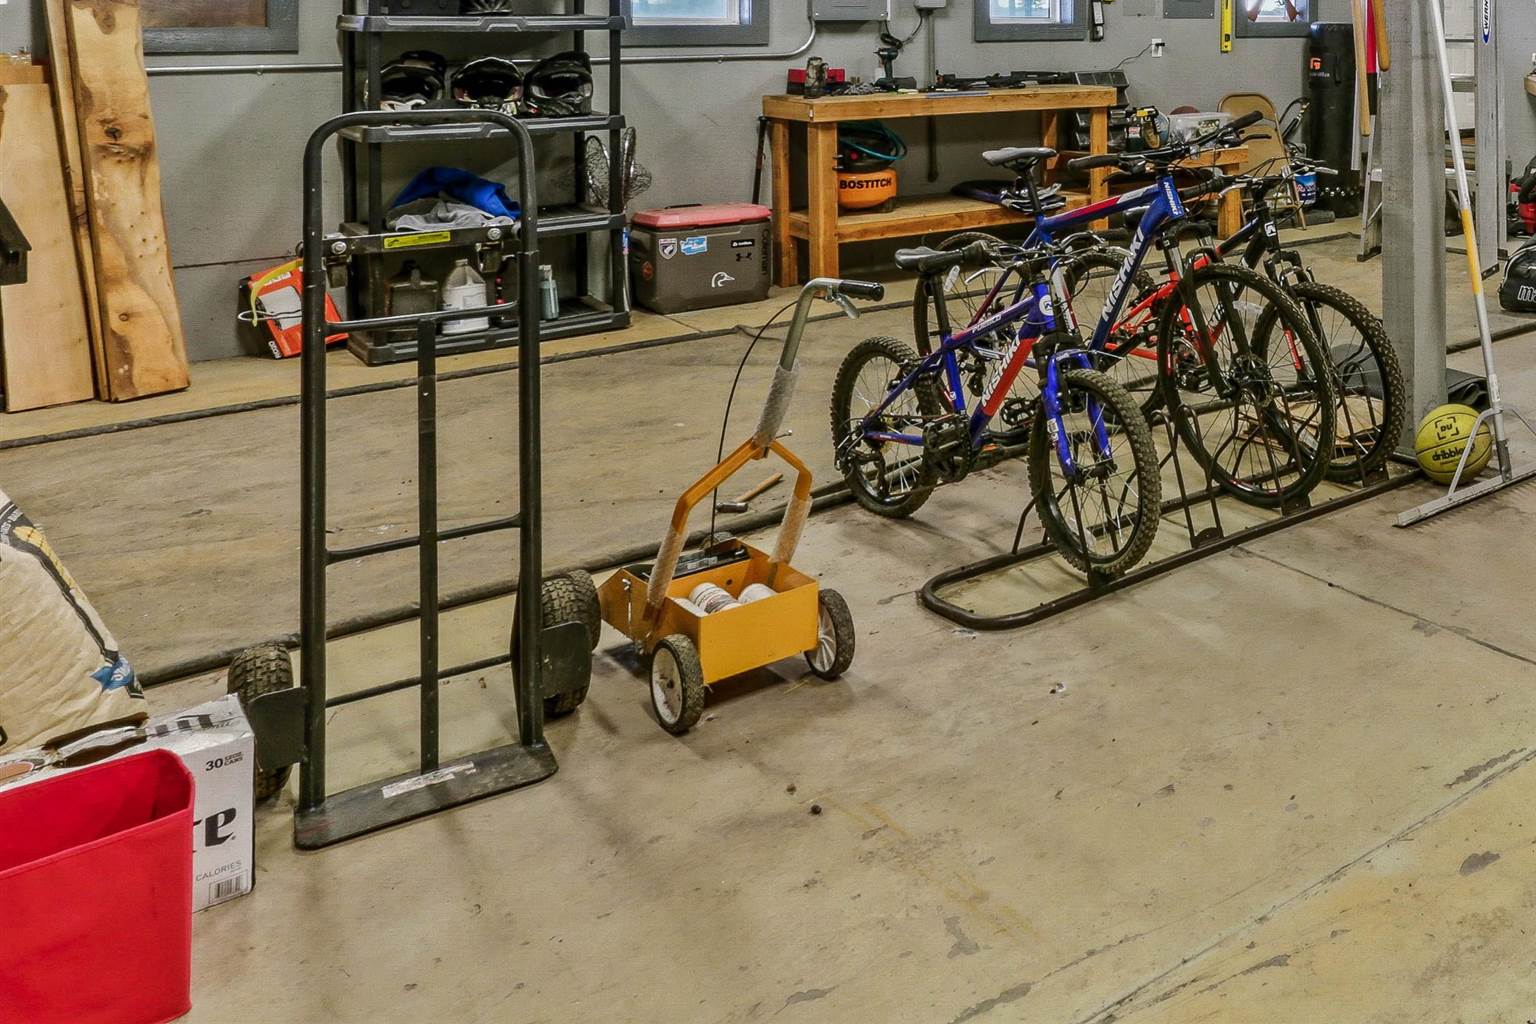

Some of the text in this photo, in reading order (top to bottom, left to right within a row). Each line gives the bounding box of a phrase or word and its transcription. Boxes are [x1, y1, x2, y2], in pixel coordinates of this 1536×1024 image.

[839, 177, 892, 190] BOSTITCH
[1101, 226, 1145, 322] NISHIKI
[205, 757, 224, 772] 30
[195, 859, 243, 882] CALORIES
